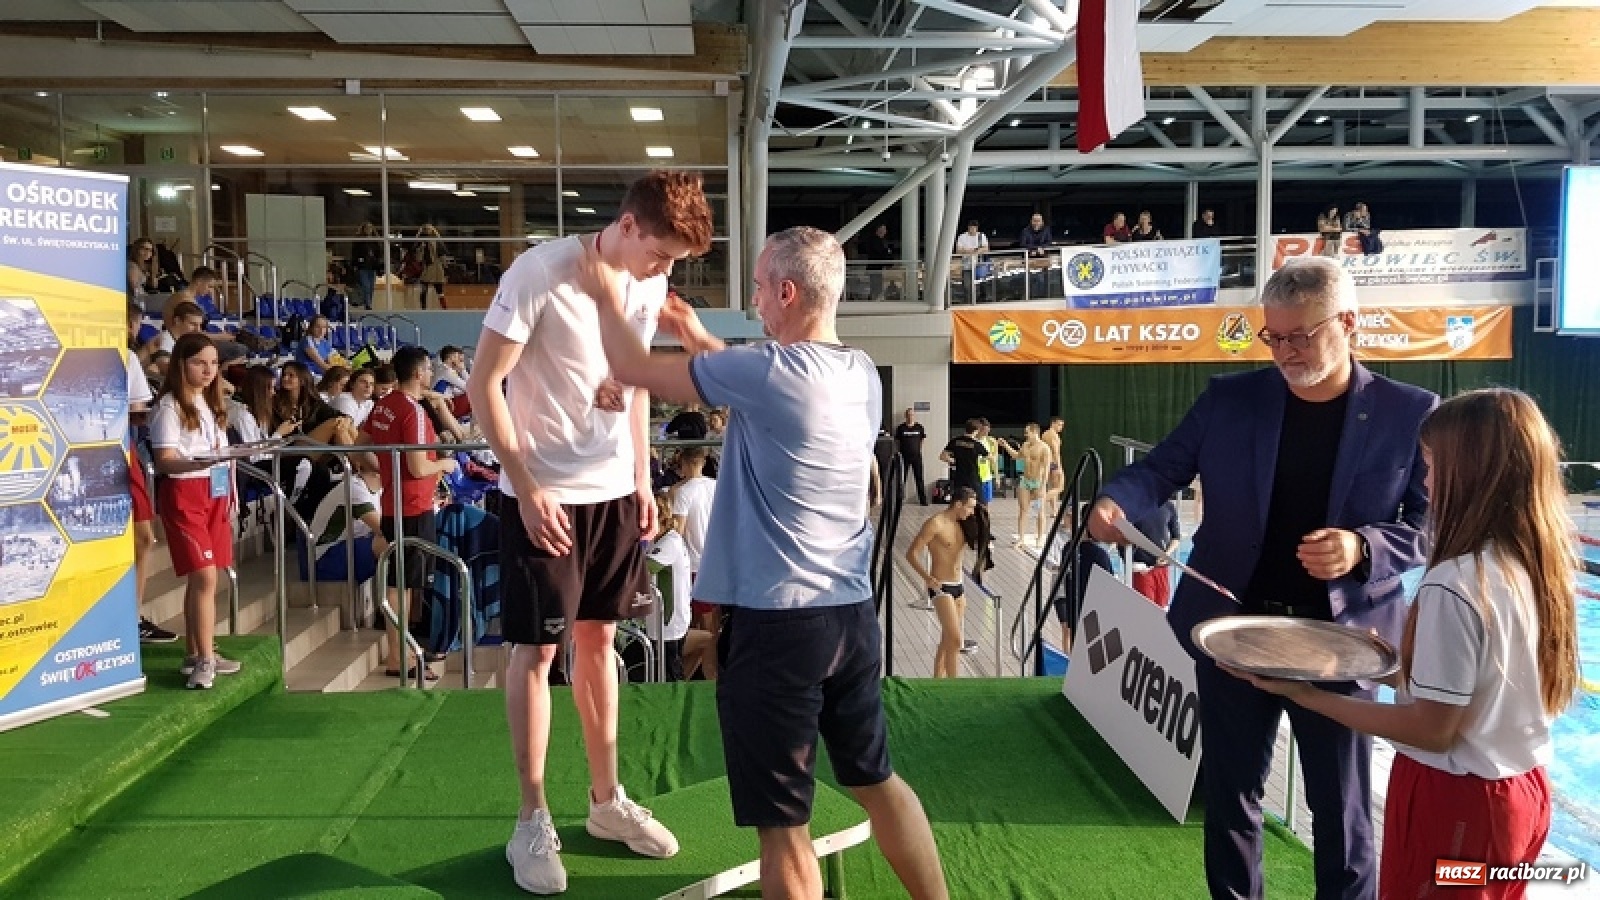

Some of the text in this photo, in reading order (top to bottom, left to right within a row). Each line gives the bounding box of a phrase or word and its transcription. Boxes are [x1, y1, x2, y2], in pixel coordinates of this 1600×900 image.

[7, 180, 118, 211] OŚRODEK
[0, 207, 118, 235] REKREACJI
[1111, 245, 1210, 261] POLSKI ZWIĄZEK
[1341, 250, 1461, 268] ROWIEC
[1110, 262, 1169, 275] PŁYWACKI
[1093, 324, 1132, 342] LAT
[1138, 322, 1201, 342] KSZO
[0, 613, 25, 627] ec.pl
[0, 620, 59, 640] r.ostrowiec
[54, 637, 121, 664] OSTROWIEC
[1120, 646, 1198, 760] arena
